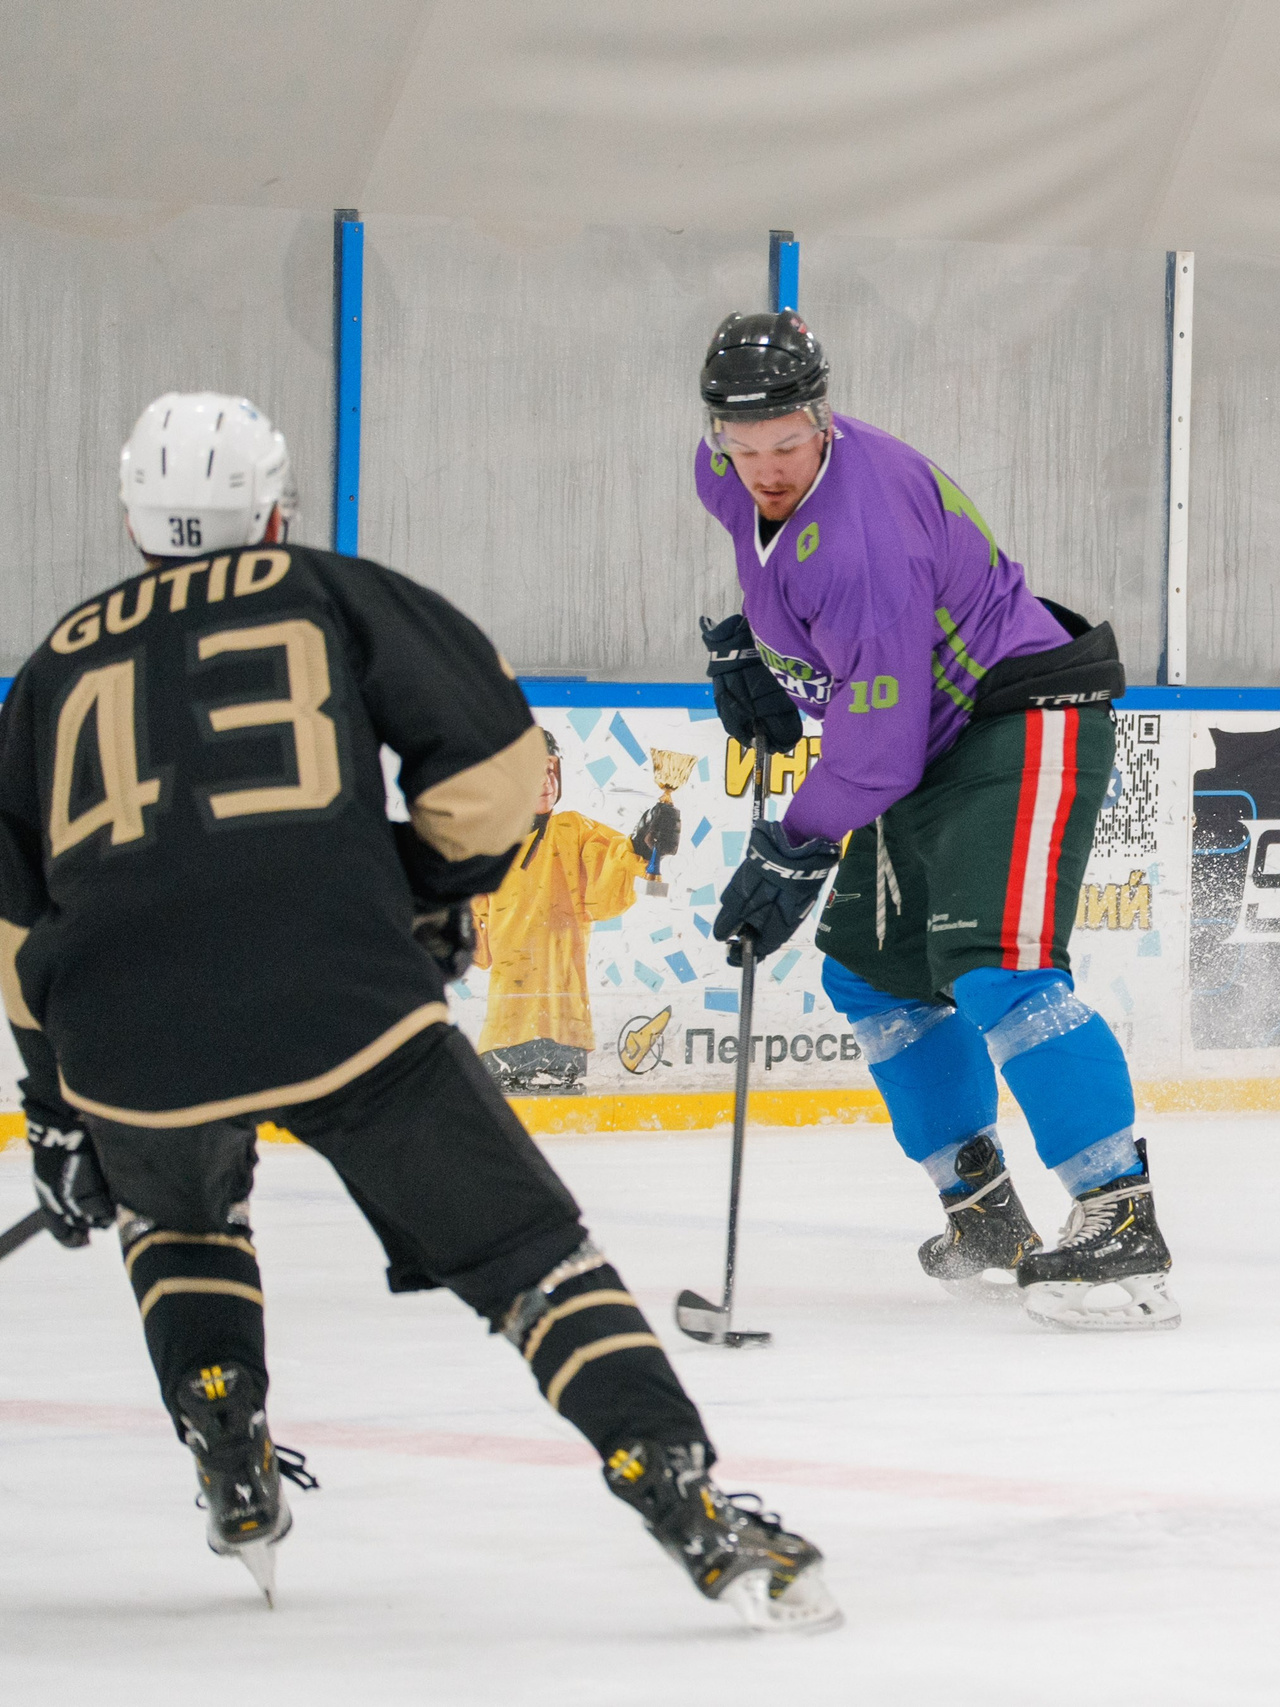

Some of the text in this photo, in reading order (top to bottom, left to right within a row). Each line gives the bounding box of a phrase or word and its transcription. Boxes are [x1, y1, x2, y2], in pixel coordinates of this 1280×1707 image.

[169, 517, 202, 548] 36
[49, 548, 291, 655] GUTID
[848, 675, 899, 714] 10
[1029, 689, 1112, 706] TRUE
[49, 618, 342, 859] 43
[750, 845, 829, 881] TRUE
